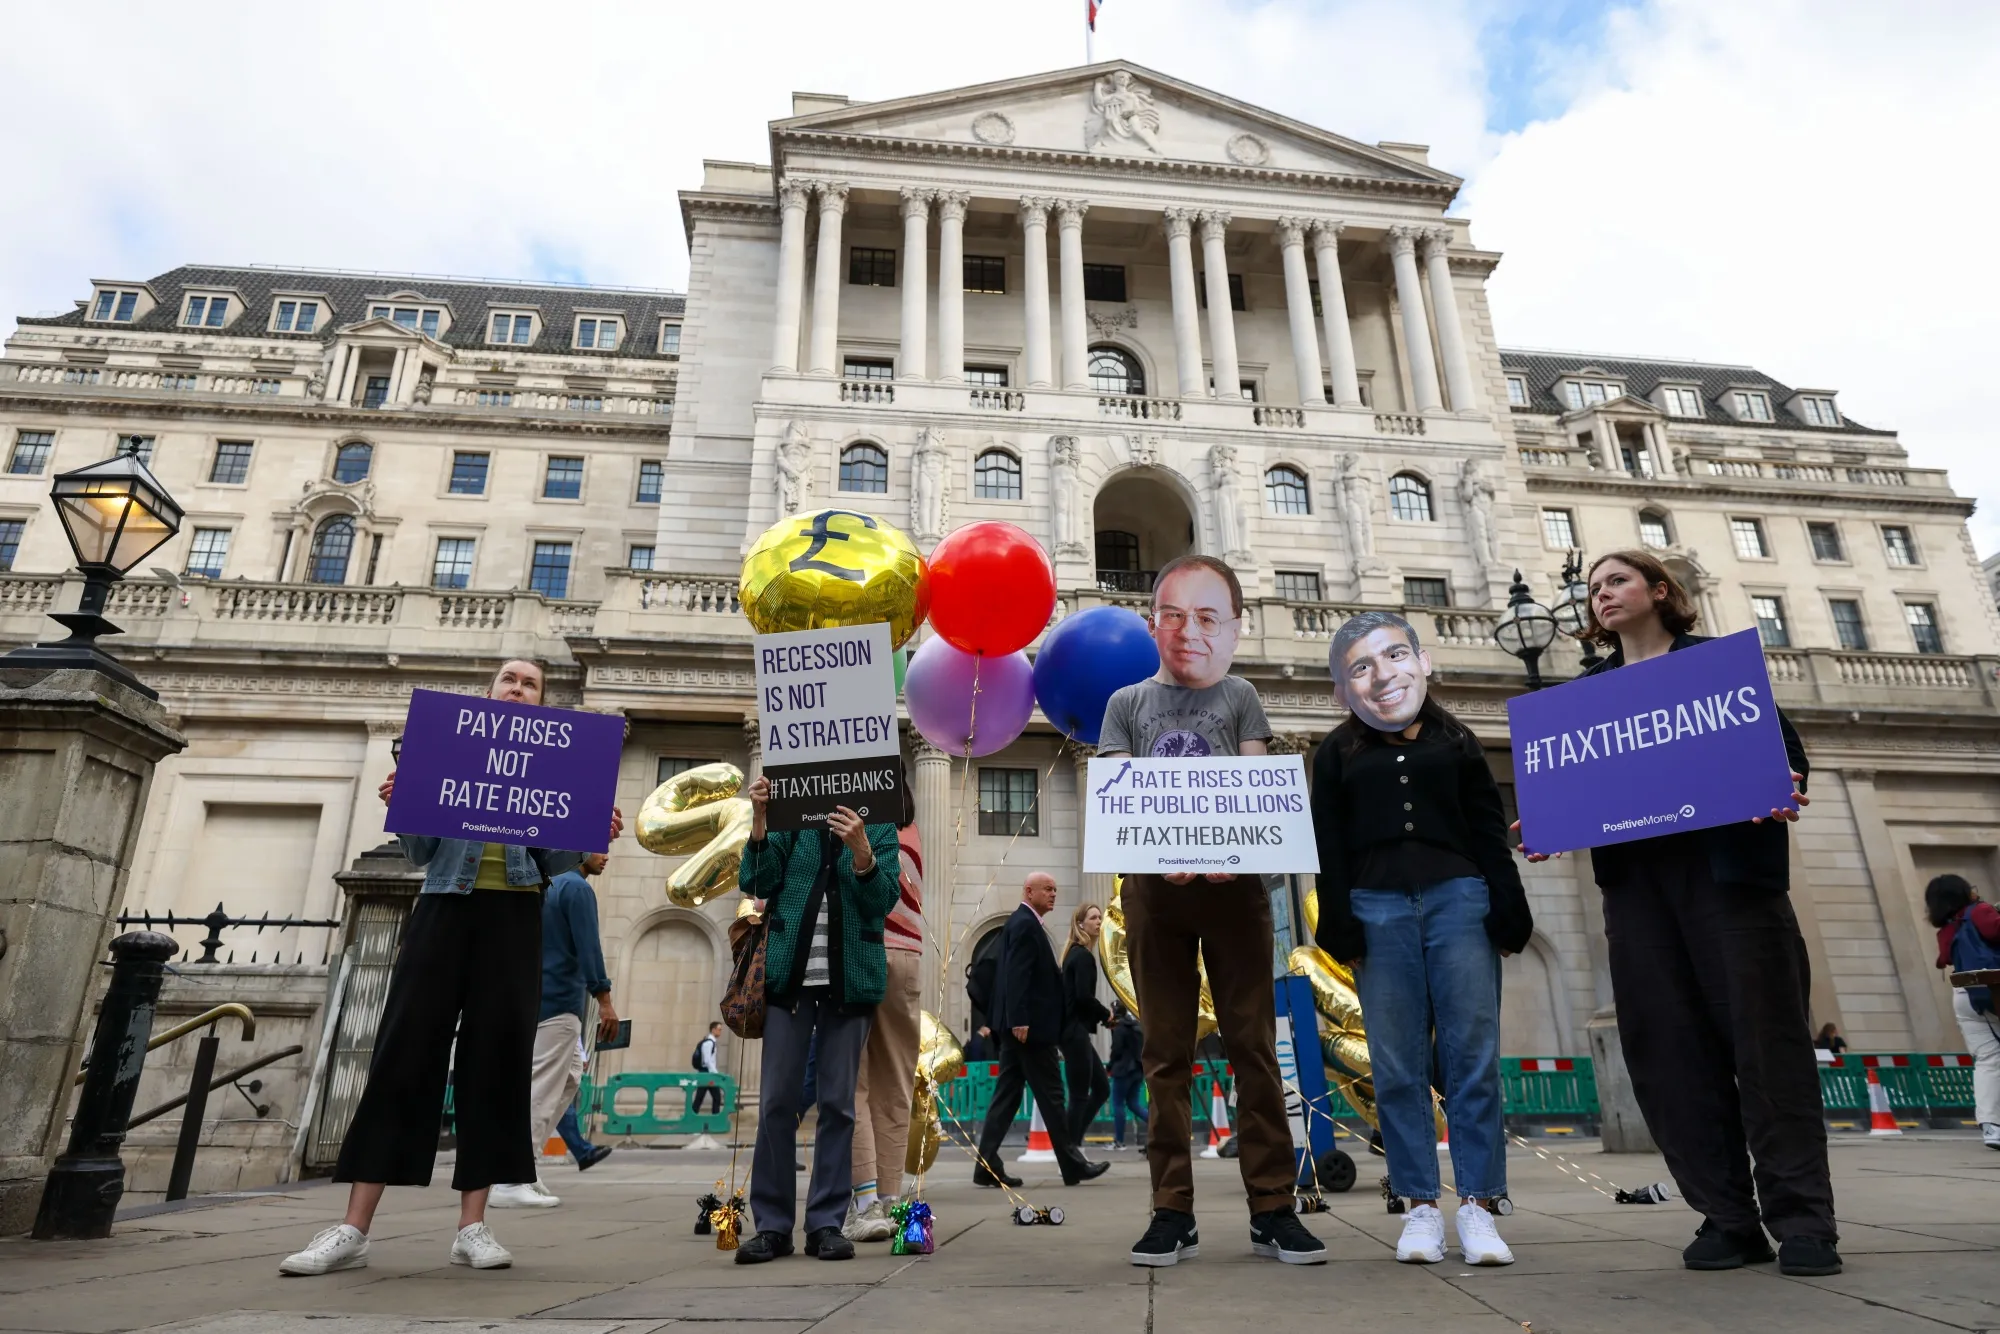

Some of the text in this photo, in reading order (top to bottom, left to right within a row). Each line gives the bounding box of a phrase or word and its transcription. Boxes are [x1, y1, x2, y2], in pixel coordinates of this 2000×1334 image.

[762, 639, 872, 675] RECESSION
[765, 682, 827, 713] IS NOT
[456, 708, 573, 749] PAY RISES
[768, 714, 892, 751] A STRATEGY
[1189, 709, 1229, 732] MONEY
[1524, 686, 1761, 774] #TAXTHEBANKS
[486, 748, 534, 779] NOT
[1132, 768, 1299, 789] RATE RISES COST
[438, 778, 572, 819] RATE RISES
[769, 769, 895, 800] #TAXTHEBANKS
[1097, 793, 1303, 814] THE PUBLIC BILLIONS
[462, 822, 525, 837] PositiveMoney
[1116, 825, 1283, 846] #TAXTHEBANKS
[1603, 811, 1679, 833] PositiveMoney
[1158, 857, 1226, 867] PositiveMoney
